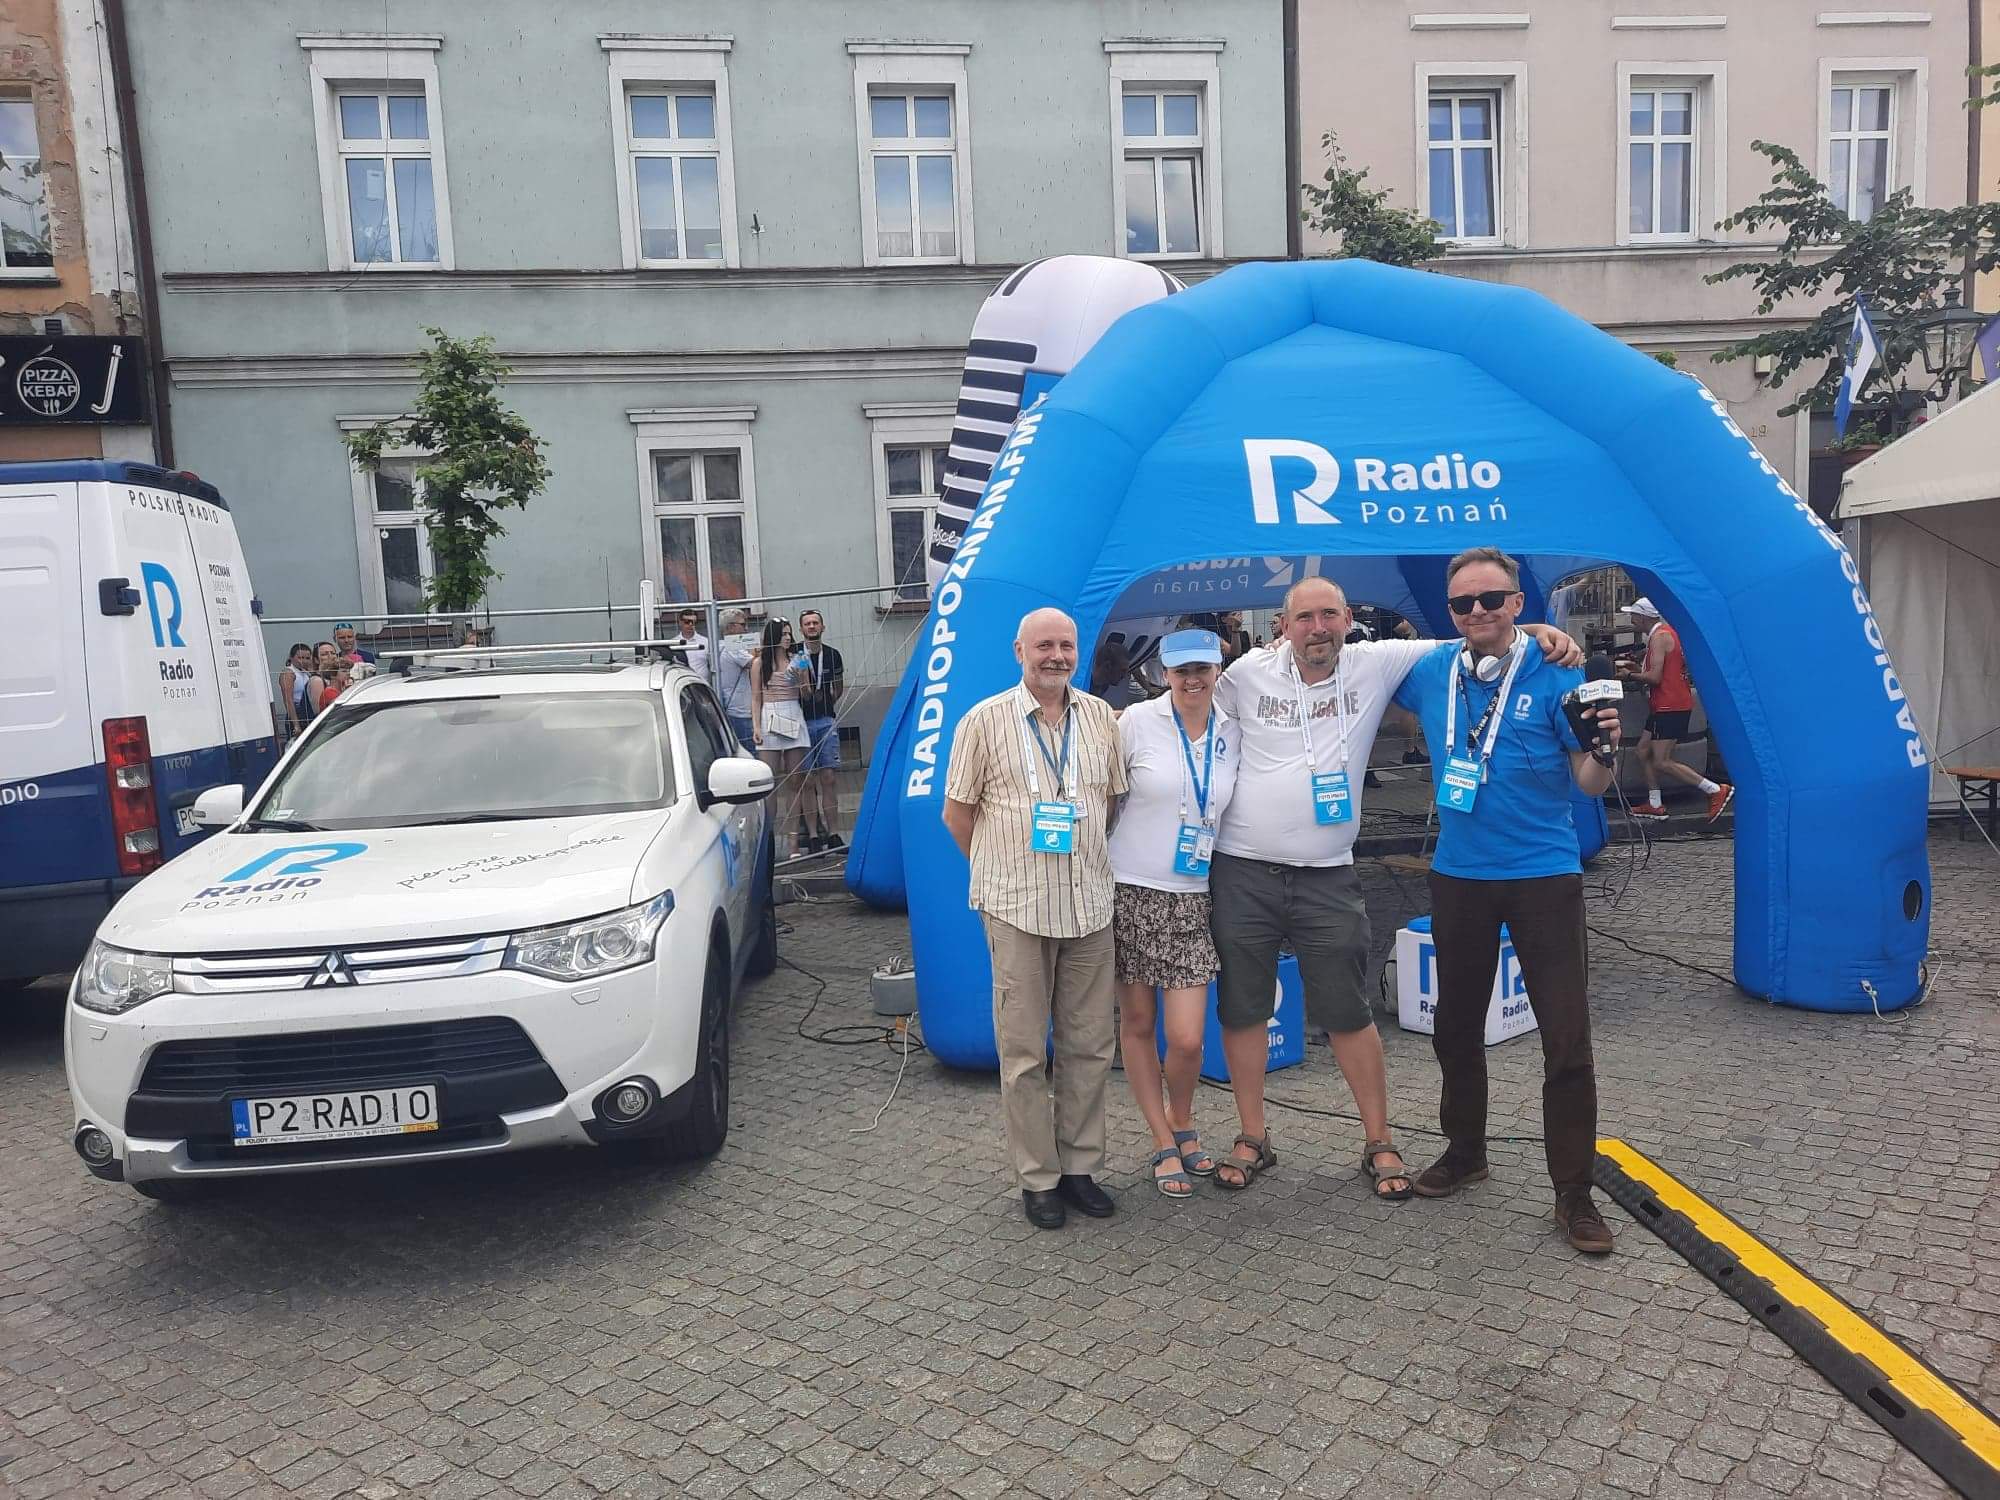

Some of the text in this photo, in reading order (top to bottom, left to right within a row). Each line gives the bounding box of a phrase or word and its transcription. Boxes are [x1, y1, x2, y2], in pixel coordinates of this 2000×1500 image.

[25, 369, 71, 382] PIZZA
[1353, 453, 1501, 492] Radio
[128, 489, 219, 524] POLSKIE RADIO
[1360, 497, 1509, 524] Poznań
[907, 412, 1043, 797] RADIOPOZNAN.FM
[159, 658, 194, 681] Radio
[0, 782, 40, 806] DIO
[397, 854, 505, 889] pierwsze
[448, 834, 625, 884] w wielkopolsce
[193, 876, 322, 899] Radio
[179, 889, 308, 912] Poznań
[1502, 1000, 1529, 1019] Radio
[254, 1101, 299, 1133] P2
[312, 1090, 430, 1130] RADIO
[235, 1123, 249, 1133] PL
